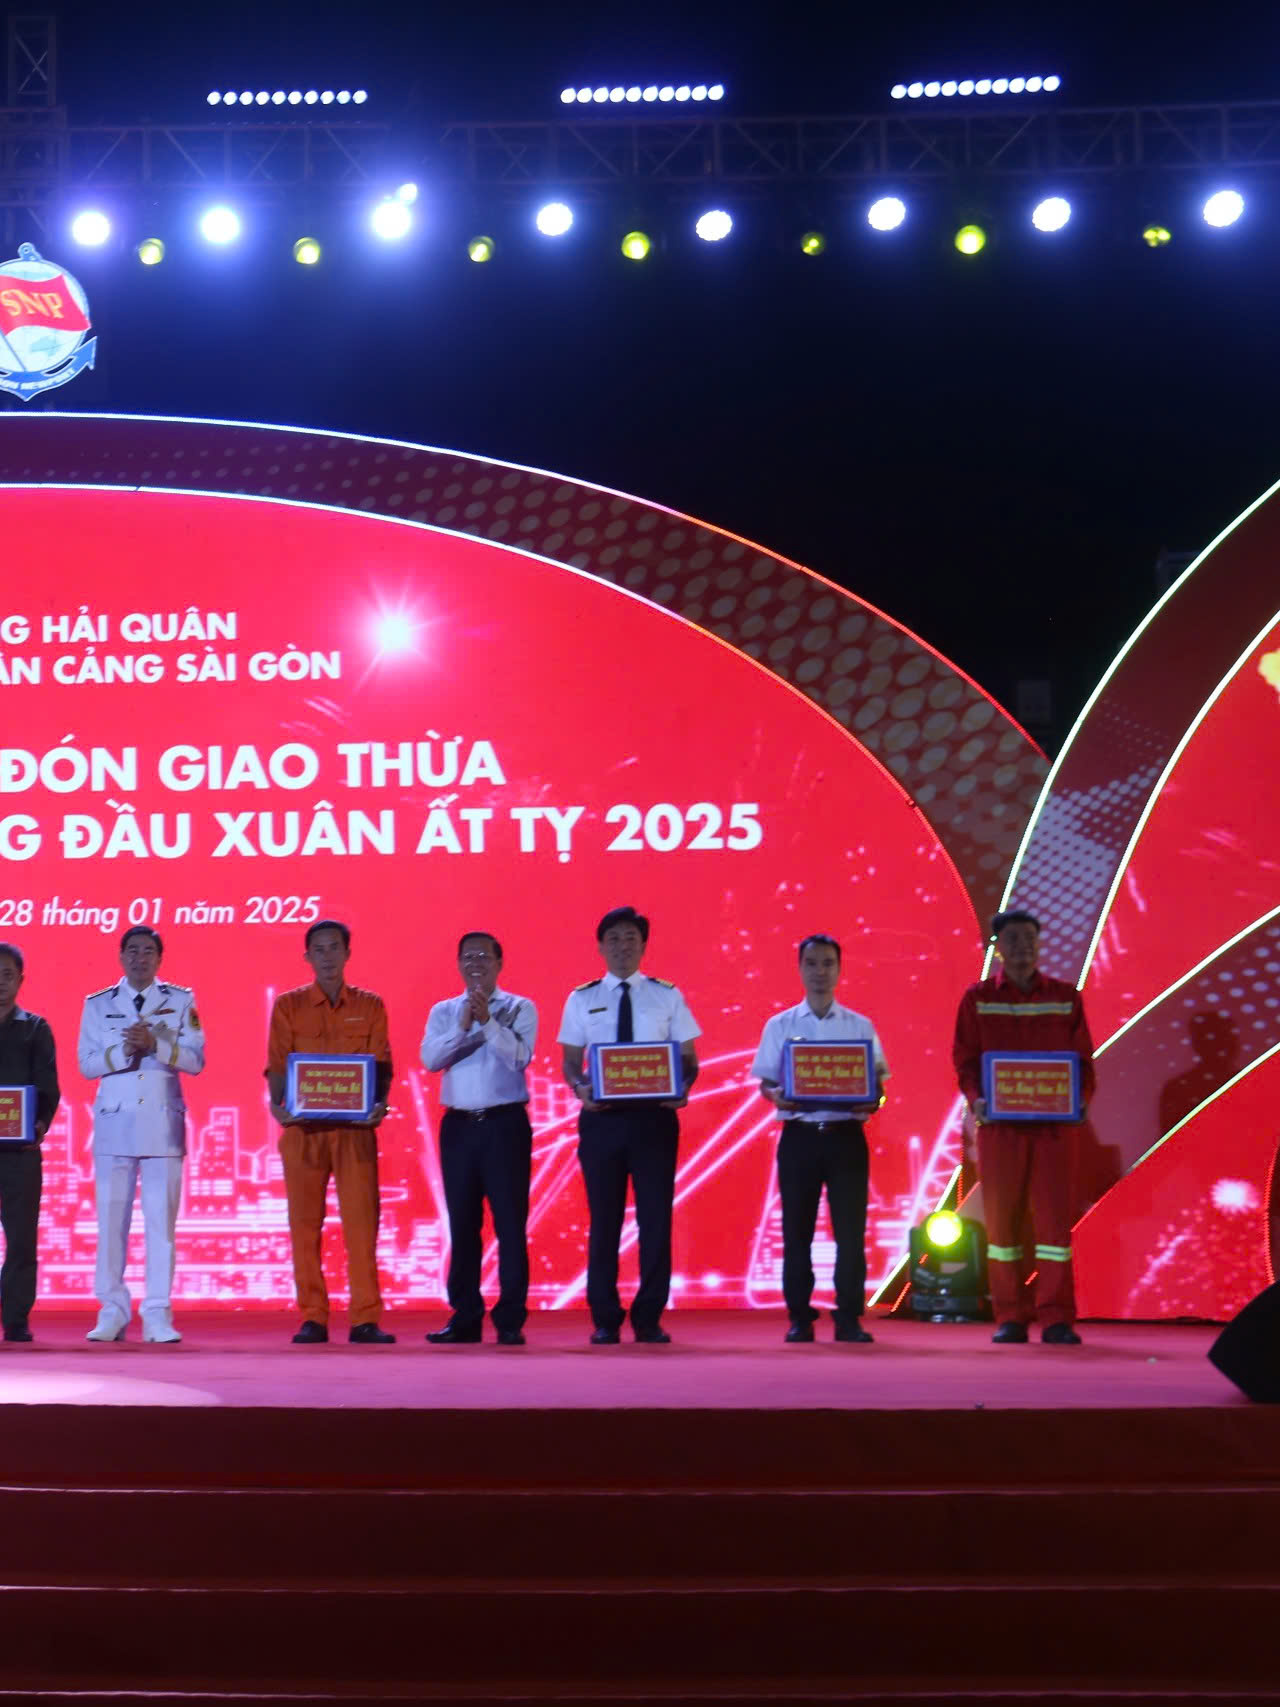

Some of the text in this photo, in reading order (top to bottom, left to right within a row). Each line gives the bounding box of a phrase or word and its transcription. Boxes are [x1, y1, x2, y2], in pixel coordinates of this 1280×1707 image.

[0, 288, 65, 319] SNP
[42, 605, 108, 644] HẢI
[121, 606, 237, 643] QUÂN
[52, 646, 165, 685] CẢNG
[176, 645, 237, 683] SÀI
[248, 643, 341, 682] GÒN
[158, 742, 320, 792] GIAO
[337, 729, 507, 788] THỪA
[58, 798, 191, 859] ĐẦU
[211, 799, 392, 858] XUÂN
[415, 793, 493, 854] ẤT
[510, 806, 585, 863] TỴ
[605, 802, 763, 852] 2025
[42, 895, 120, 934] tháng
[128, 897, 162, 925] 01
[174, 899, 235, 925] năm
[244, 895, 321, 924] 2025
